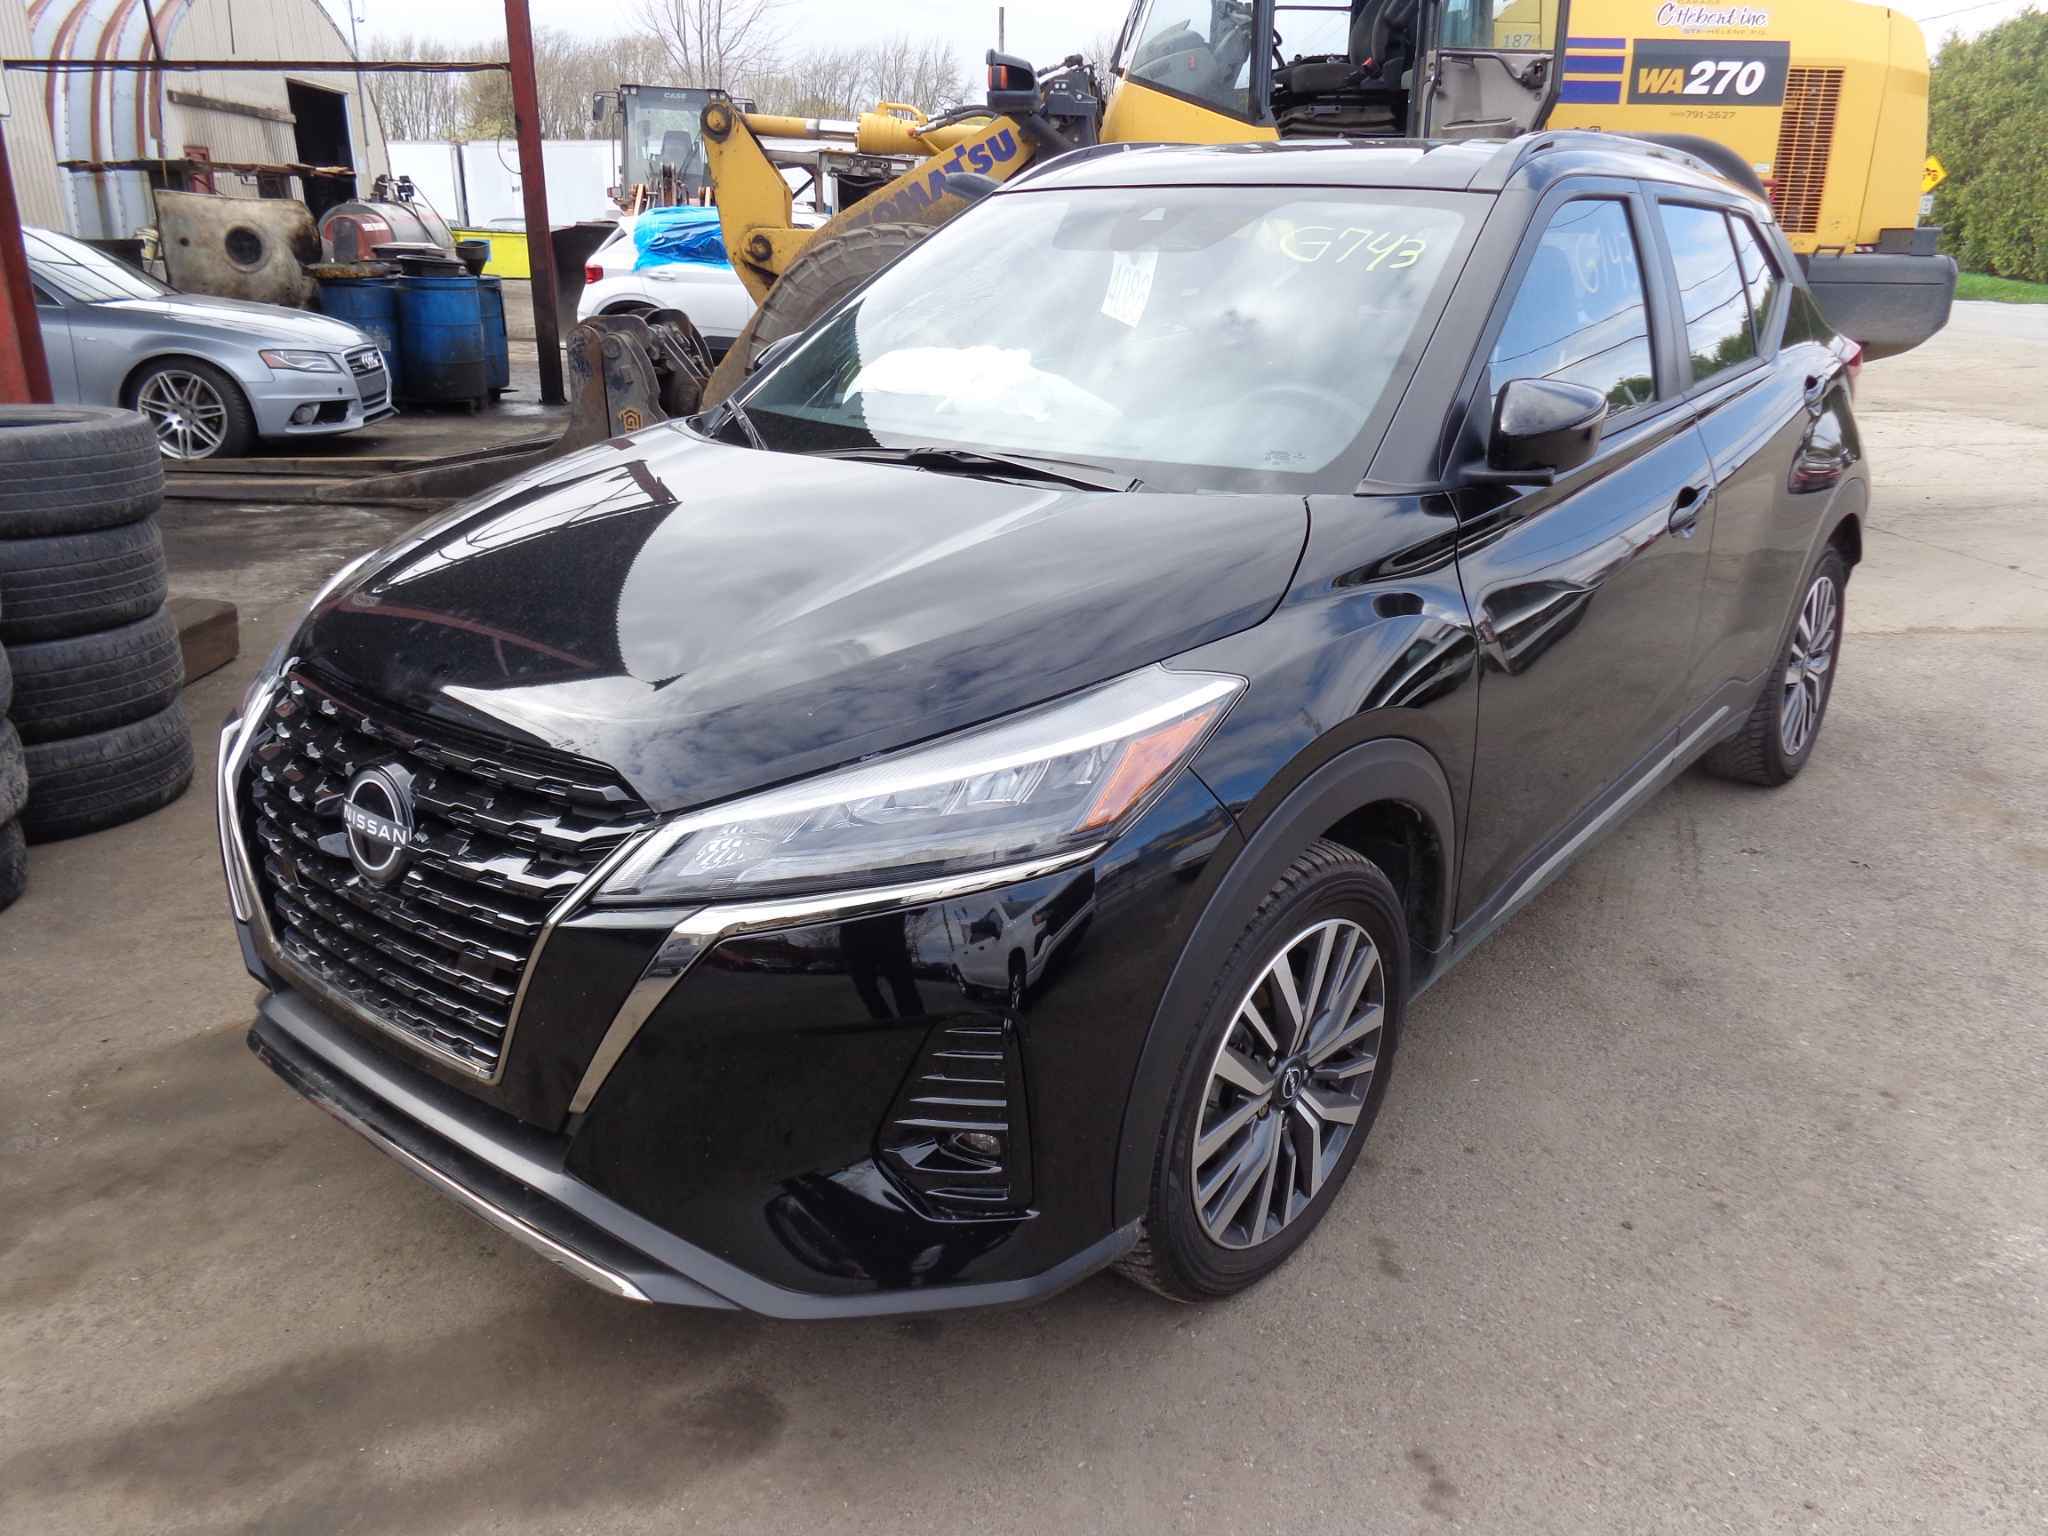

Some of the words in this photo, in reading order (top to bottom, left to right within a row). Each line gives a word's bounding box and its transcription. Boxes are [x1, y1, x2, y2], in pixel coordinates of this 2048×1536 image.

[1638, 60, 1766, 96] WA270
[1279, 225, 1427, 272] G743
[343, 804, 407, 845] NISSAN
